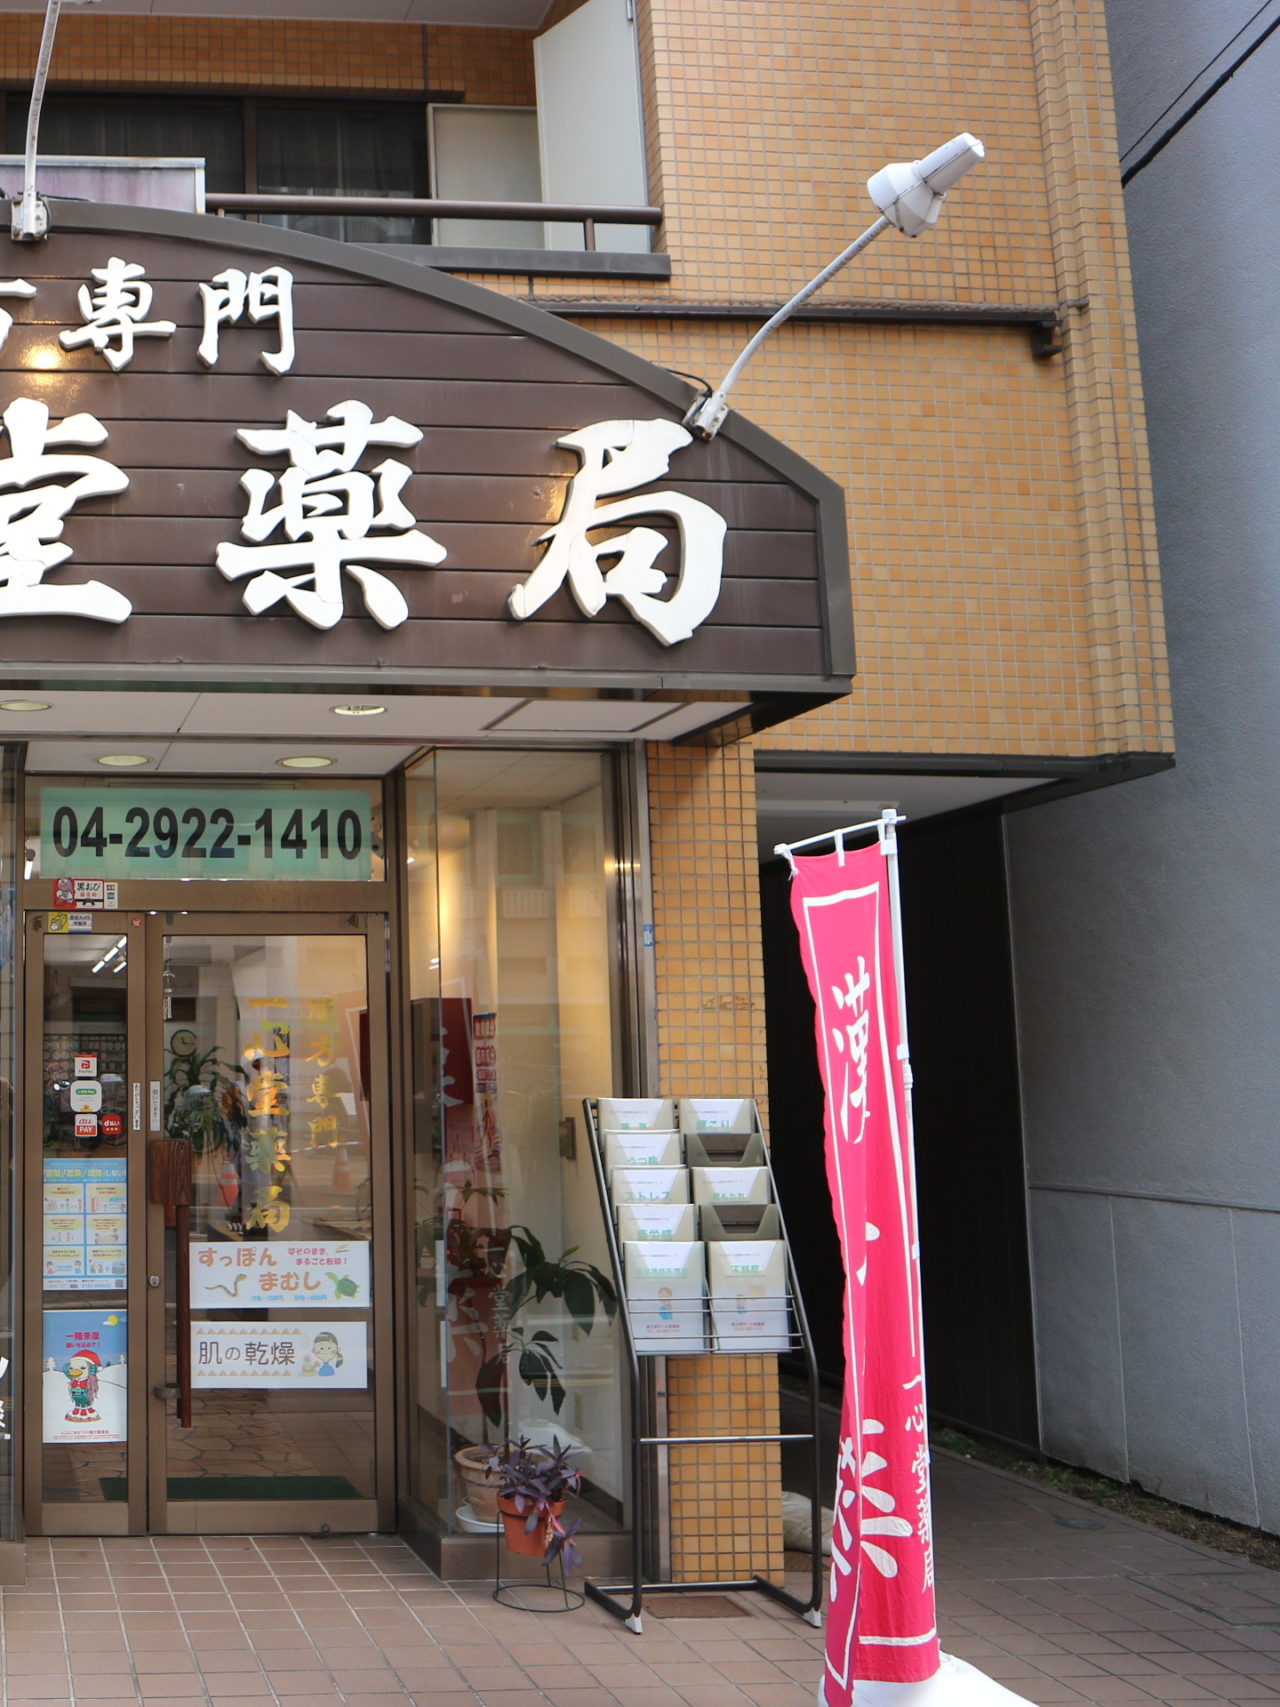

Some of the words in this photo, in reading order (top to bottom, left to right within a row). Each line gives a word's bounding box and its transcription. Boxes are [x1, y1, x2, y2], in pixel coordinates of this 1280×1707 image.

[52, 806, 363, 860] 04-2922-1410
[244, 996, 292, 1233] 一心堂薬局
[197, 1246, 278, 1267] すっぽん
[258, 1271, 322, 1292] まむし
[197, 1341, 296, 1366] 肌の乾燥
